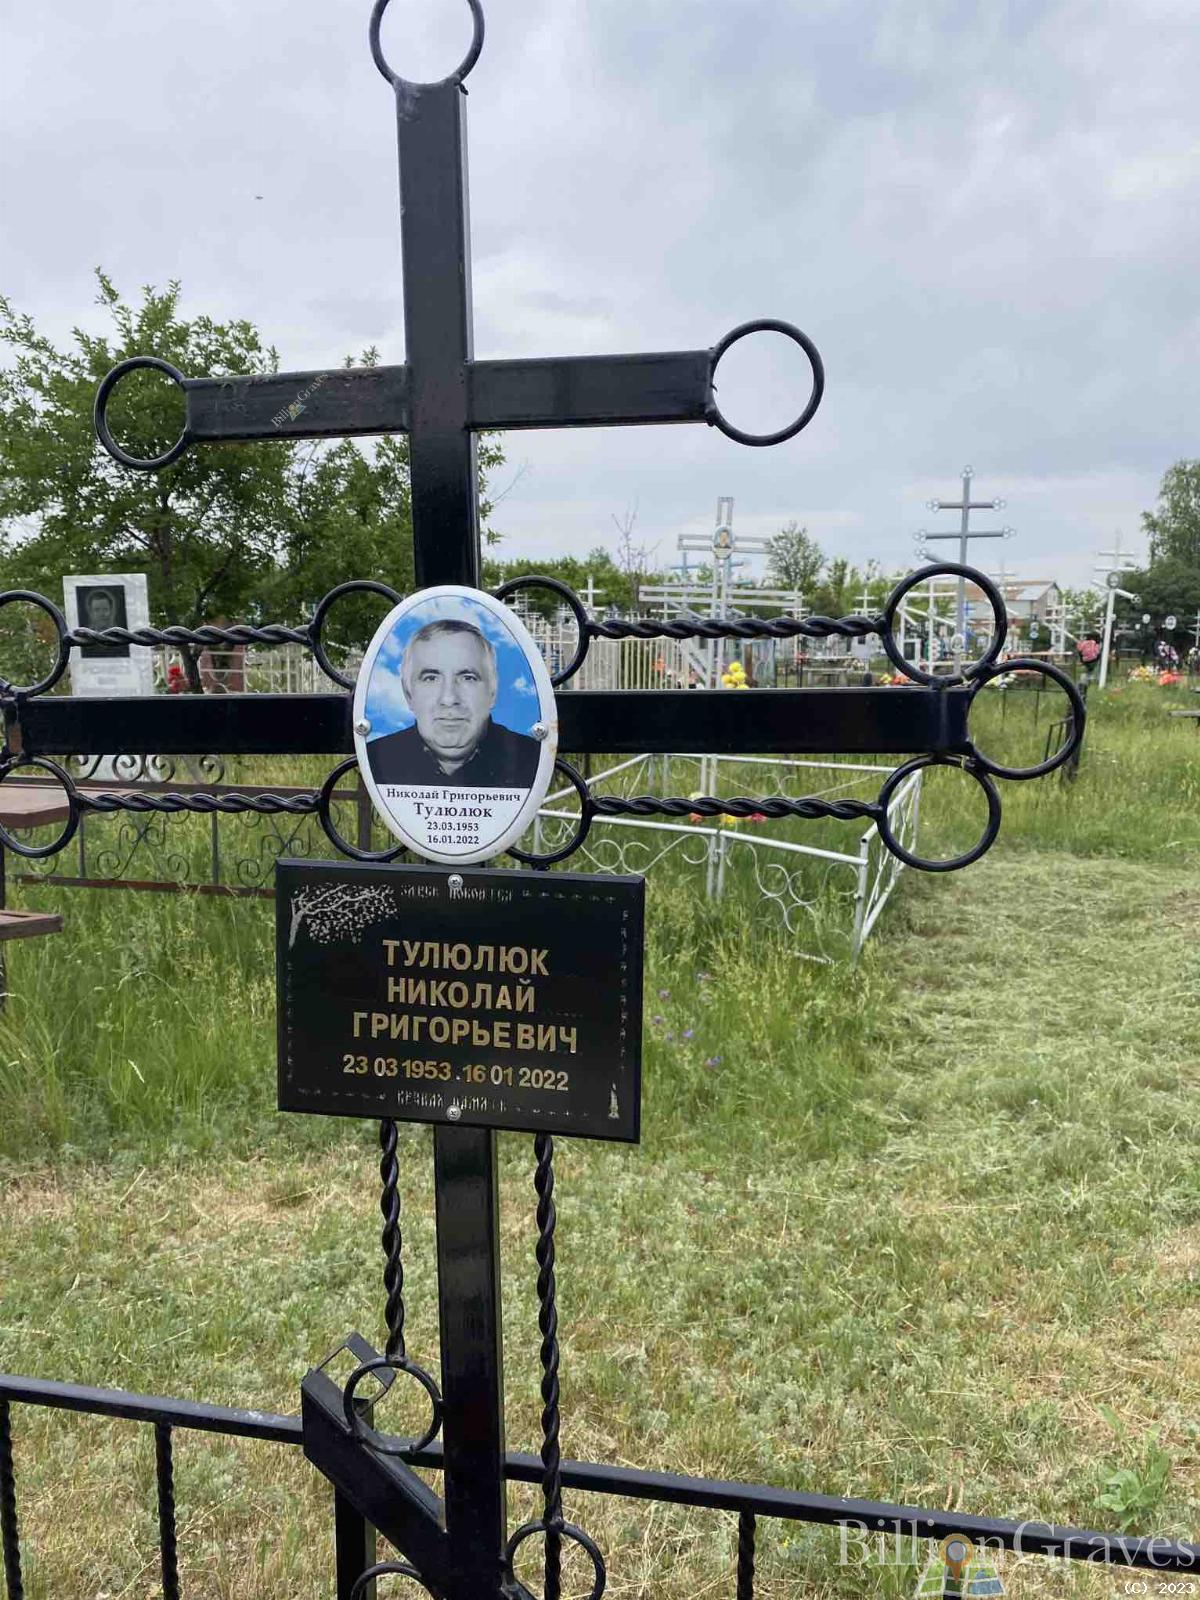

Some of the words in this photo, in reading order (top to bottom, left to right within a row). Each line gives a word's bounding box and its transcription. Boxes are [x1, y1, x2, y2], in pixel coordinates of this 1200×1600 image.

[387, 788, 439, 800] Николай
[443, 790, 520, 803] Григорьевич
[413, 802, 492, 819] Тулюлюк
[427, 821, 479, 832] 23.03.1953
[428, 835, 480, 845] 16.01.2022
[382, 939, 550, 977] ТУЛЮЛЮК
[387, 976, 536, 1013] НИКОЛАЙ
[353, 1012, 578, 1054] ГРИГОРЬЕВИЧ
[343, 1054, 368, 1075] 23
[374, 1057, 398, 1077] 03
[490, 1066, 513, 1086] 01
[519, 1067, 569, 1091] 2022
